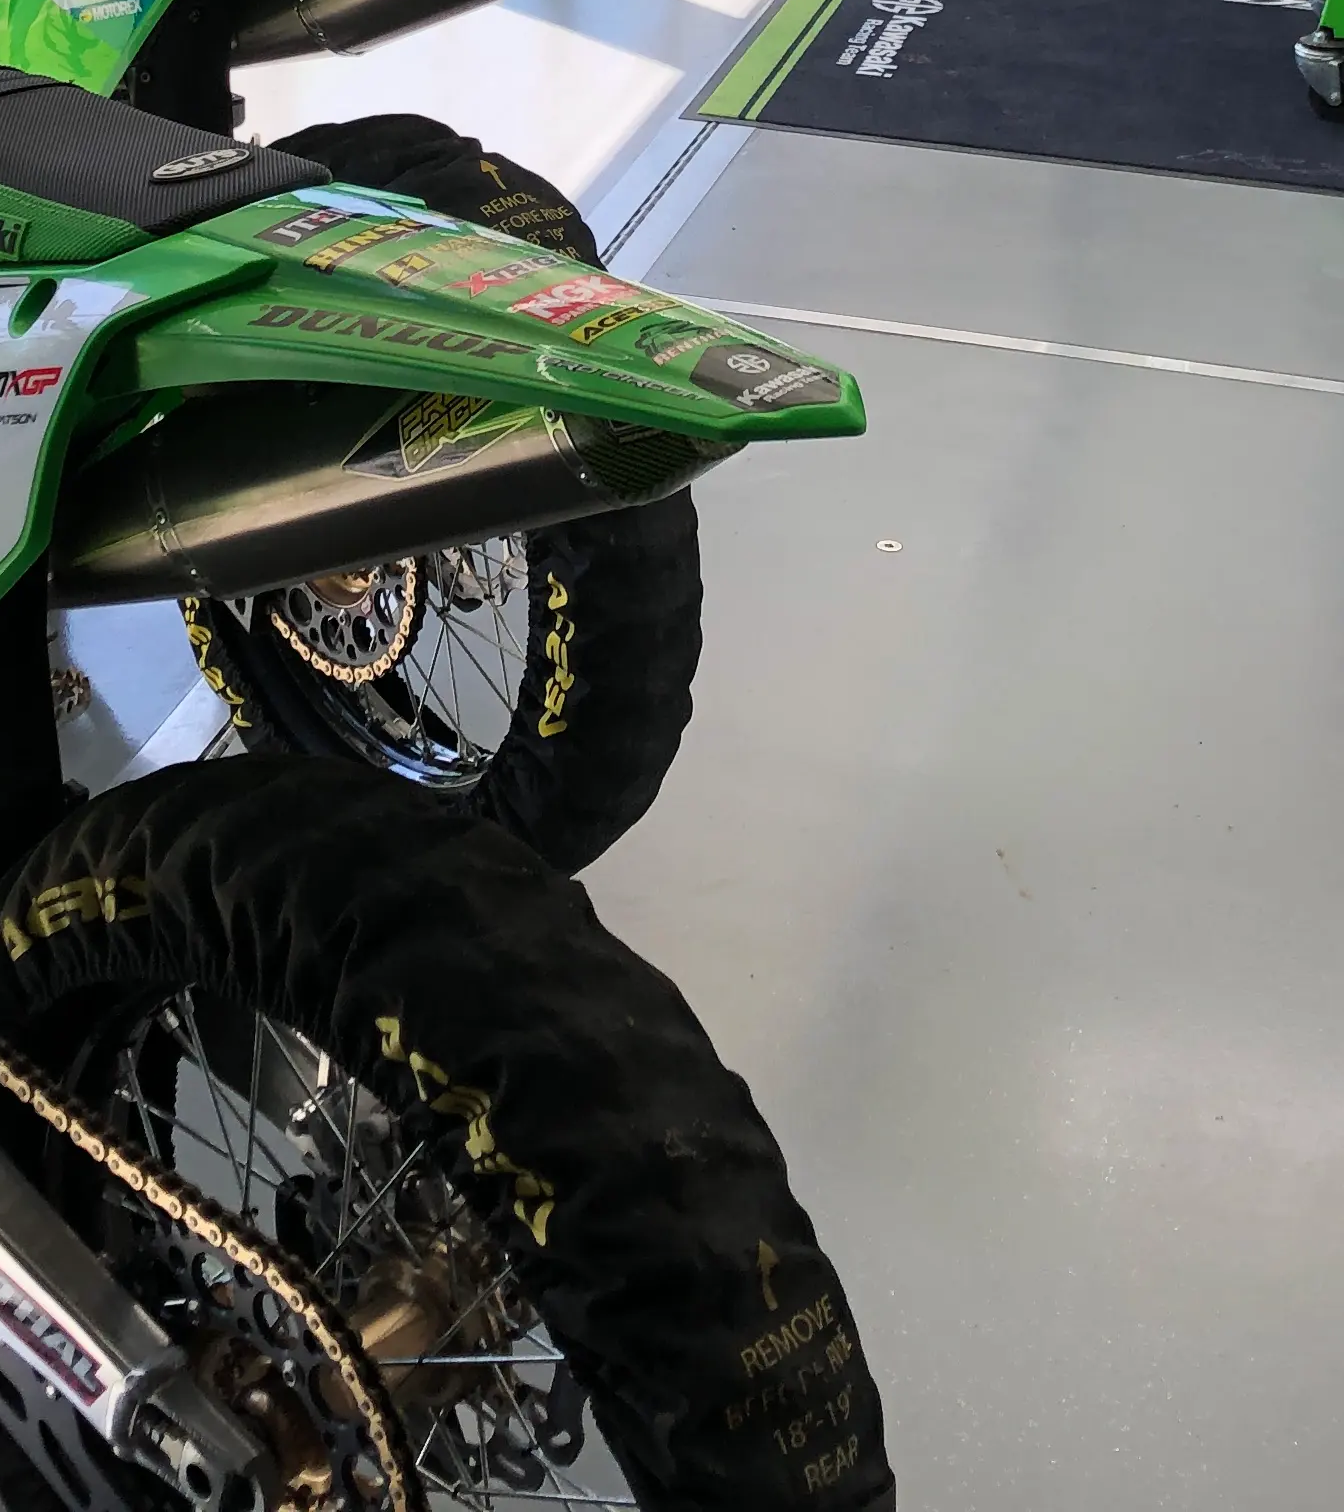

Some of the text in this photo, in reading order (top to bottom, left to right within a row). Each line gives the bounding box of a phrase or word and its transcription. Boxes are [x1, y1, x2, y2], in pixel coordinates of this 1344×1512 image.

[856, 14, 928, 78] Kawasaki
[248, 304, 537, 359] DUNLOP
[740, 1292, 835, 1379] REMOVE
[804, 1433, 859, 1494] REAR
